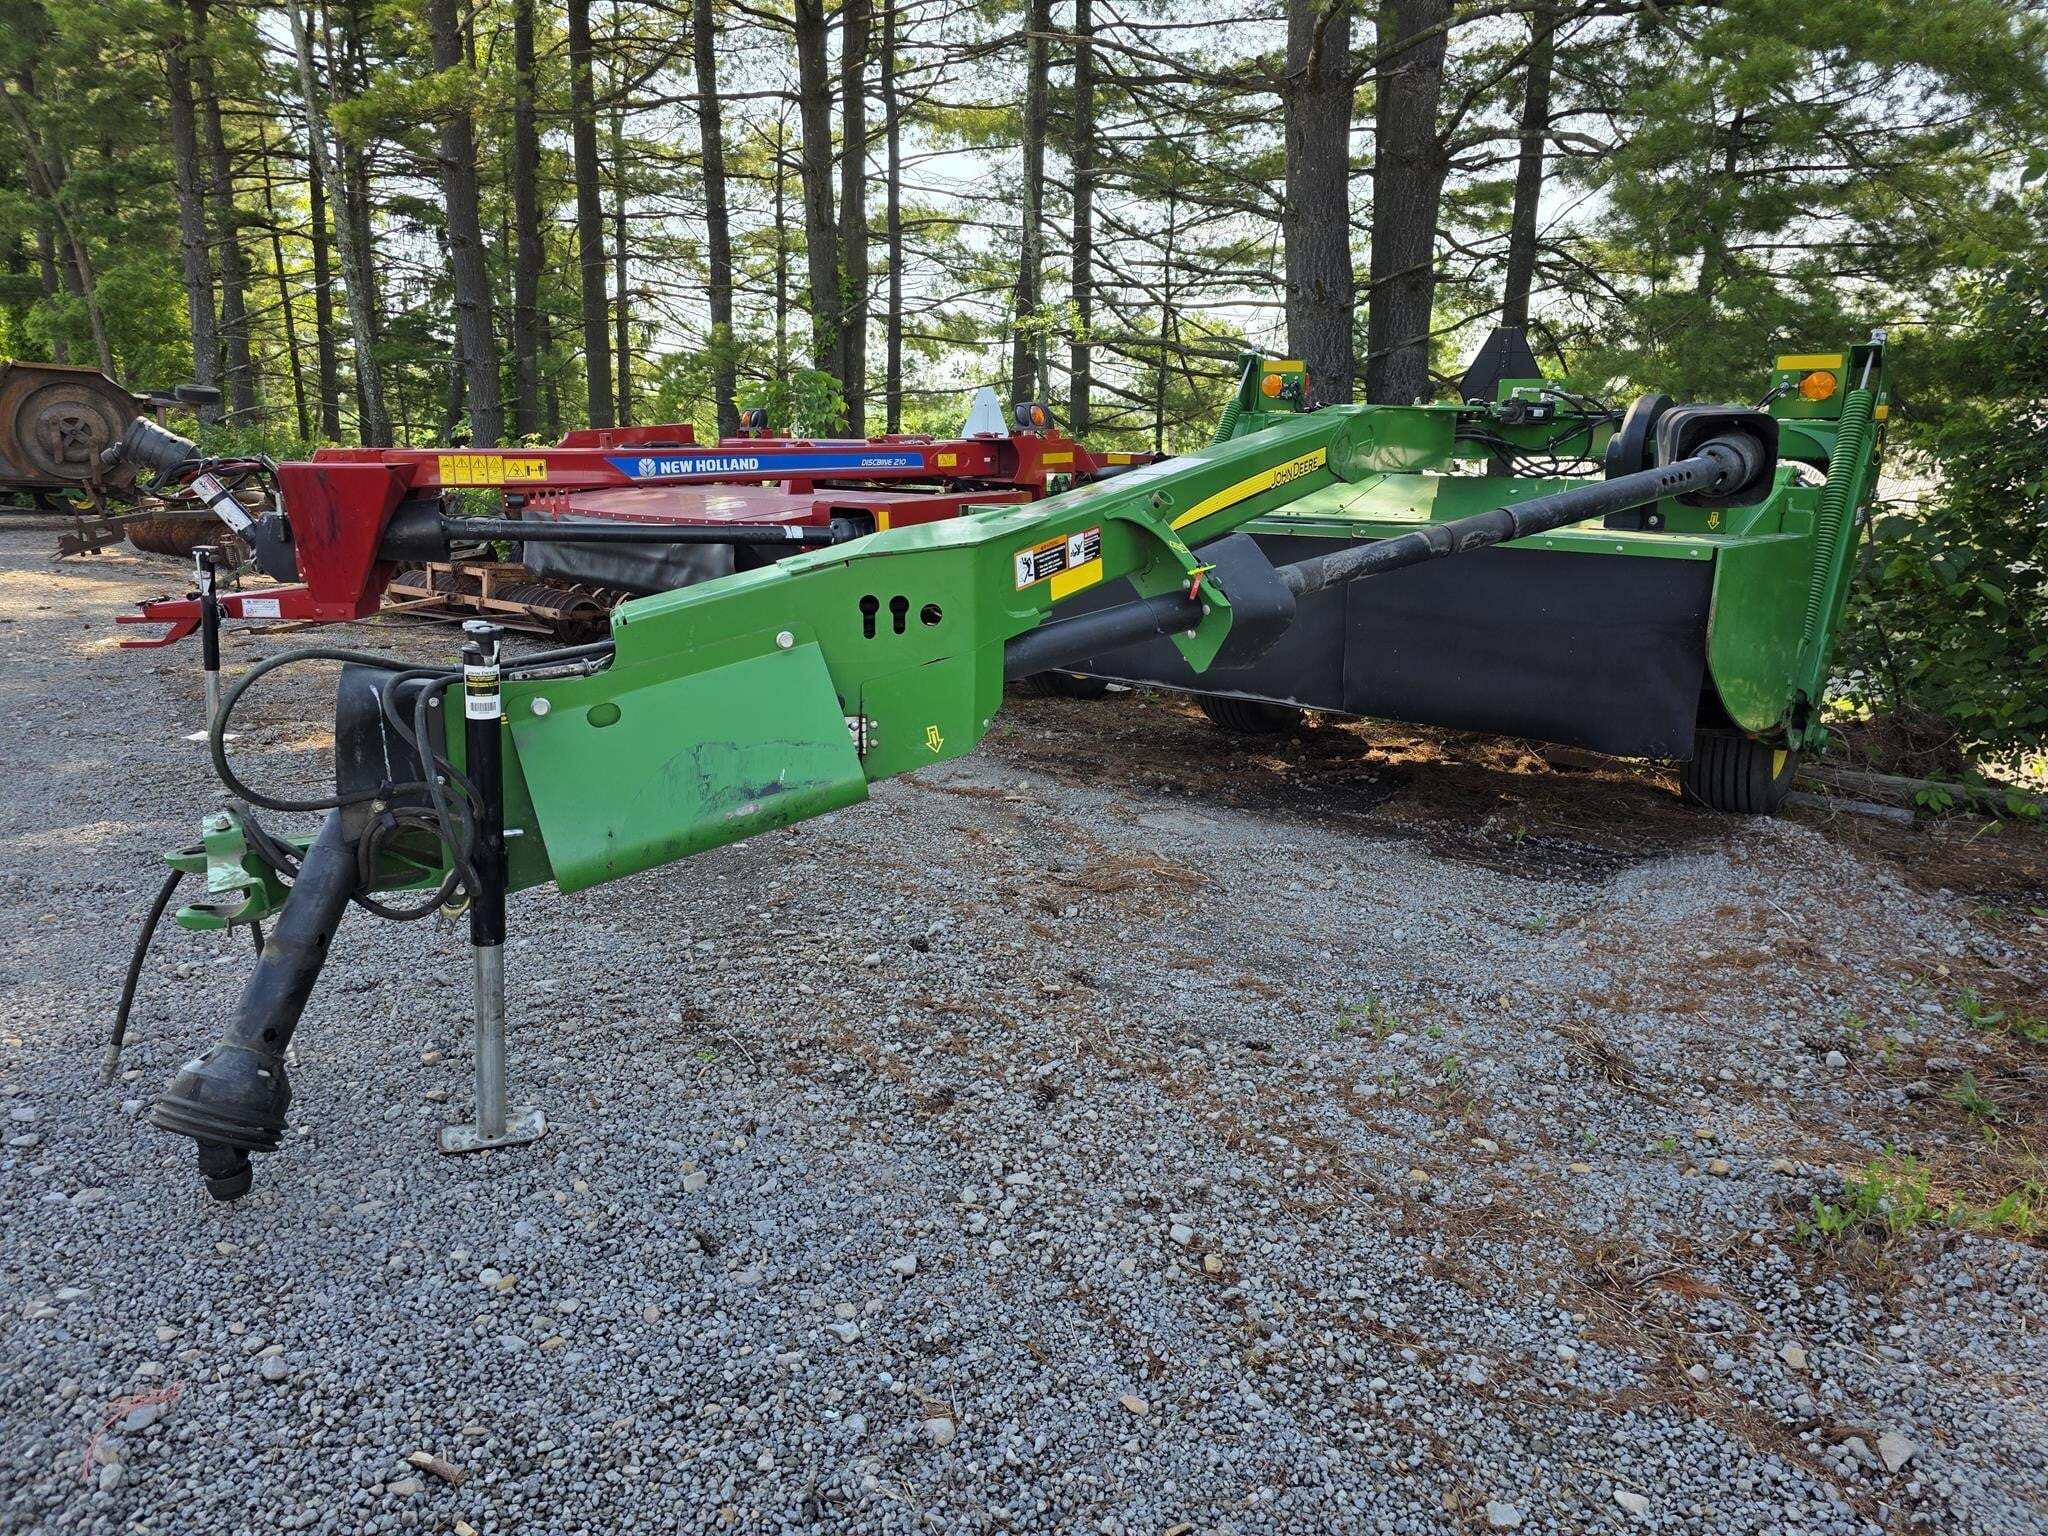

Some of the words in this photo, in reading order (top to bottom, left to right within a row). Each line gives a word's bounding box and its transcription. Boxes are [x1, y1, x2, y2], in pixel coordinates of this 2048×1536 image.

[660, 460, 693, 474] NEW
[695, 458, 759, 472] HOLLAND
[861, 458, 892, 467] DISCBINE
[893, 458, 907, 466] 210
[1271, 466, 1293, 488] JOHN
[1293, 457, 1319, 478] DEERE
